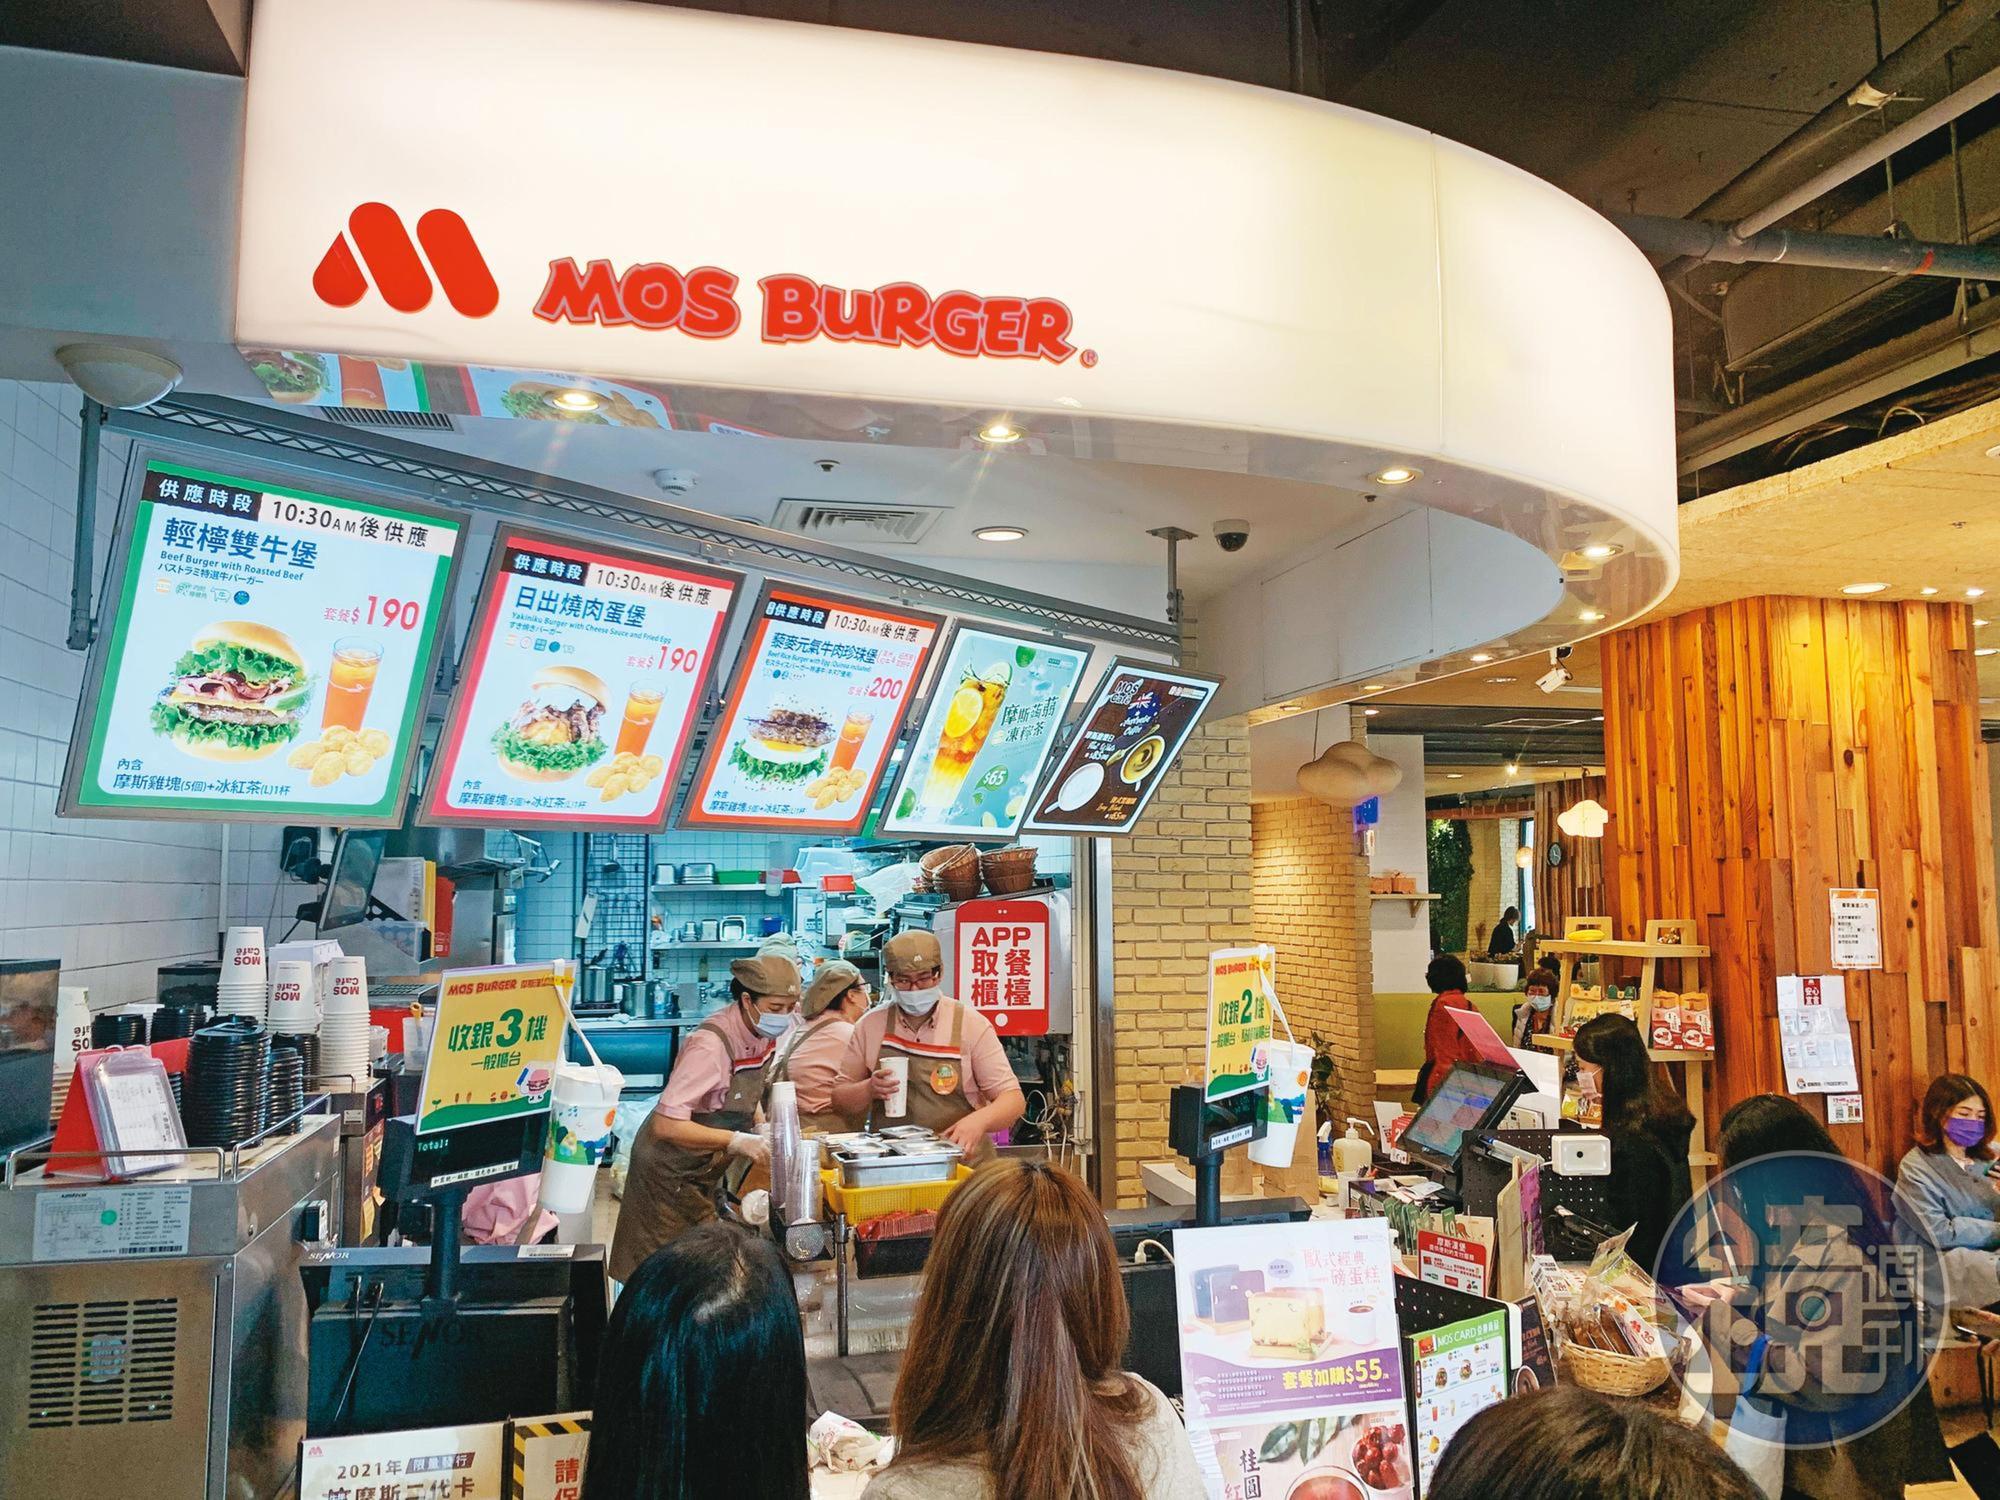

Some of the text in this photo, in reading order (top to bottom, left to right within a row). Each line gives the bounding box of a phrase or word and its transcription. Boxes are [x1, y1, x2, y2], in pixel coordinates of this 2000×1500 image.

[533, 257, 1077, 366] MOS BURGER
[158, 478, 253, 513] 供應時段
[162, 517, 318, 570] 輕檸雙牛堡
[160, 550, 305, 582] Beef Burger with Roasted Beef
[515, 553, 583, 581] 供應時段
[516, 586, 647, 628] 日出燒肉蛋堡
[512, 611, 542, 622] Yakiniku
[545, 617, 568, 629] Burger
[569, 622, 584, 630] with
[585, 624, 609, 634] Cheese
[630, 632, 642, 640] and
[1115, 681, 1139, 695] MOS
[982, 770, 1007, 787] $65
[972, 926, 1032, 947] APP
[234, 956, 261, 966] MOS
[236, 947, 260, 956] Café
[971, 948, 1032, 977] 取餐
[277, 983, 300, 992] Café
[333, 986, 360, 995] MOS
[335, 977, 359, 986] Café
[447, 983, 474, 996] MOS
[476, 979, 517, 994] BURGER
[274, 992, 300, 1001] MOS
[1218, 988, 1265, 1026] 收銀2機
[448, 1008, 548, 1052] 收銀3機
[471, 1051, 521, 1071] 一般櫃台
[417, 1139, 449, 1152] Total:
[308, 1251, 350, 1263] SENOR
[1454, 1327, 1477, 1341] CARD
[337, 1459, 403, 1480] 2021年
[1239, 1448, 1262, 1499] 桂圓
